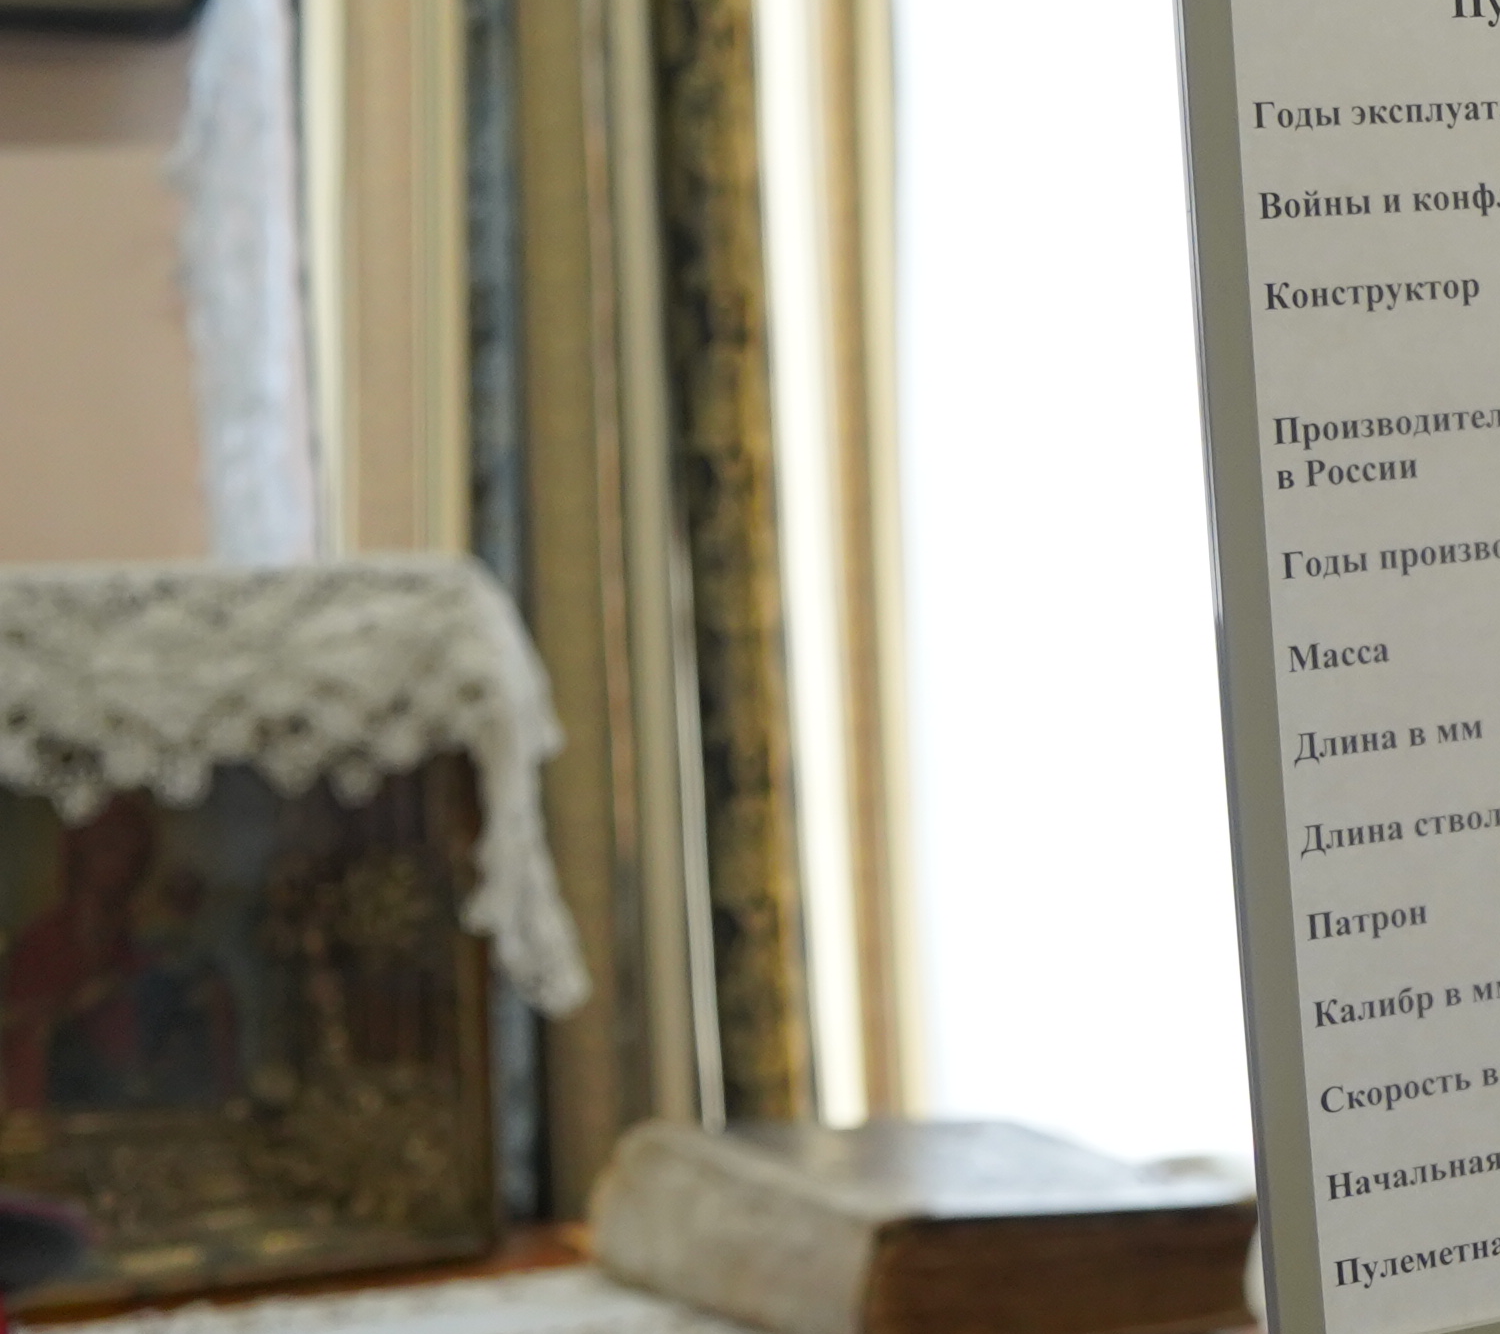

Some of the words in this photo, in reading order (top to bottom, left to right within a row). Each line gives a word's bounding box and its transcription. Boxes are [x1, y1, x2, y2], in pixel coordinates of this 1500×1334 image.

[1251, 100, 1342, 132] Годы
[1257, 188, 1372, 221] Войны
[1381, 192, 1402, 215] и
[1263, 277, 1481, 314] Конструктор
[1276, 468, 1296, 491] в
[1304, 458, 1419, 489] России
[1280, 549, 1369, 581] Годы
[1286, 641, 1391, 674] Масса
[1292, 729, 1399, 768] Длина
[1407, 726, 1428, 748] в
[1436, 719, 1484, 745] мм
[1299, 820, 1405, 860] Длина
[1305, 904, 1428, 942] Патрон
[1312, 986, 1435, 1029] Калибр
[1444, 986, 1463, 1008] в
[1319, 1072, 1473, 1115] Скорость
